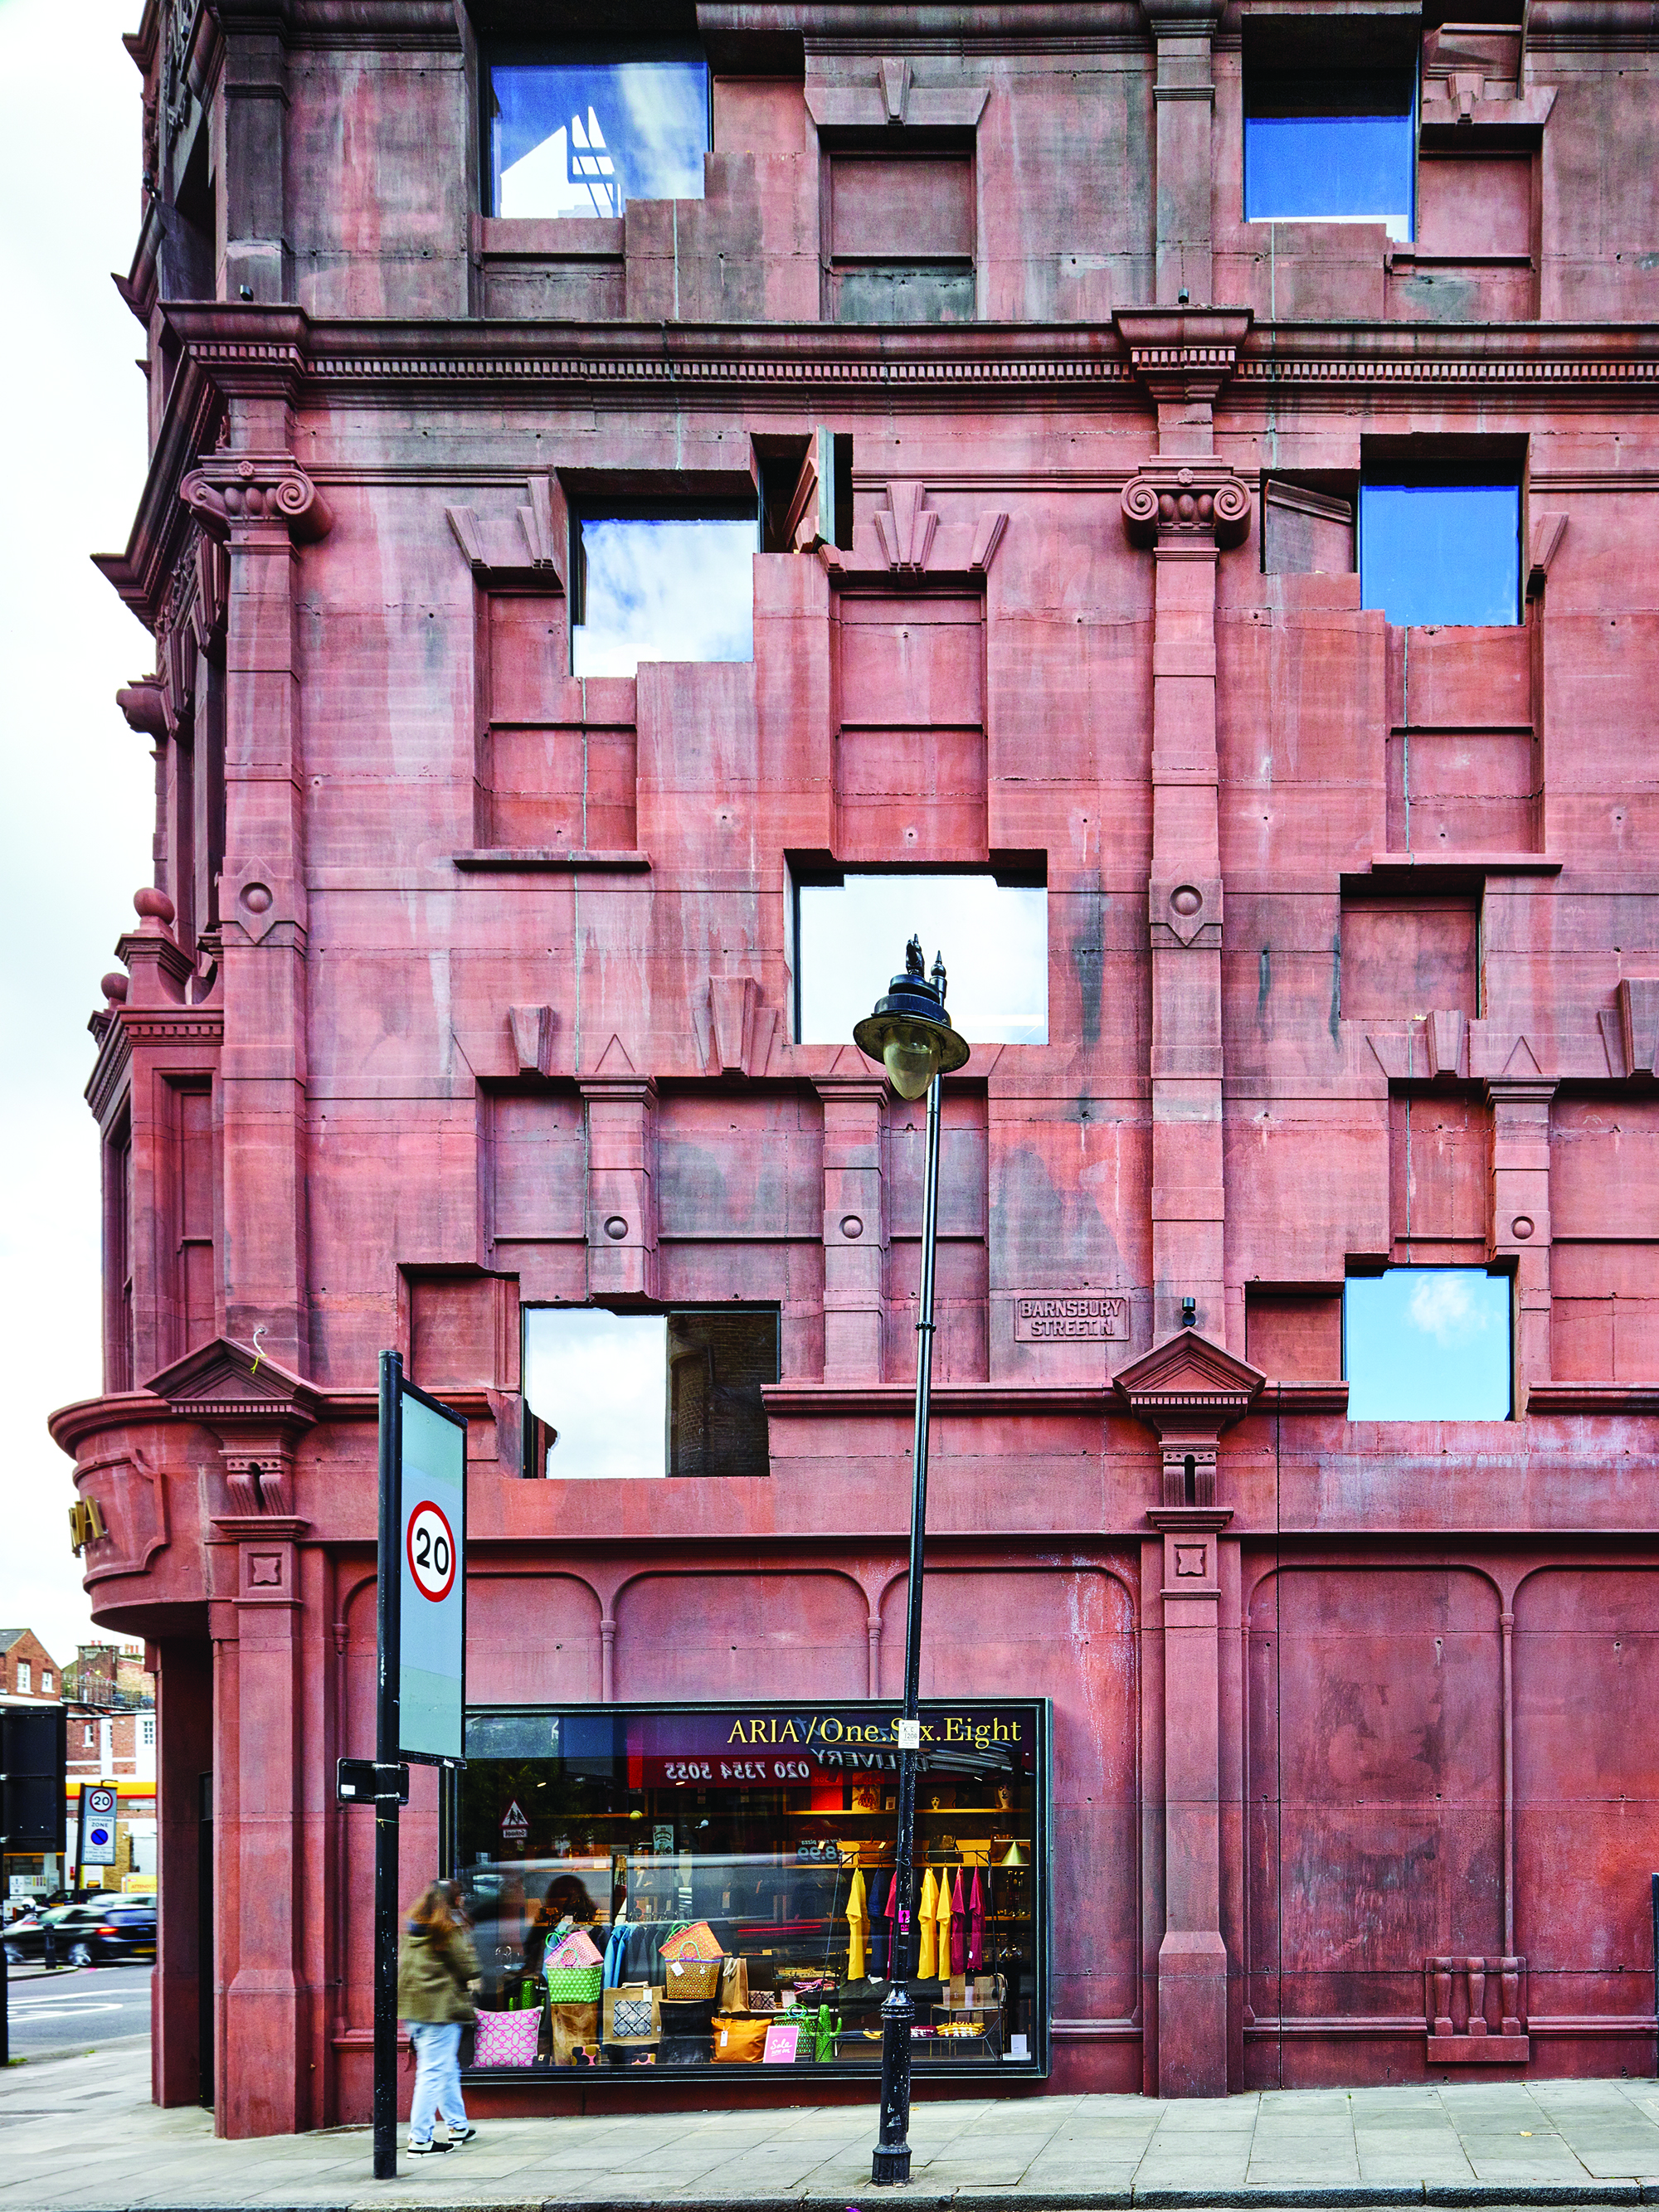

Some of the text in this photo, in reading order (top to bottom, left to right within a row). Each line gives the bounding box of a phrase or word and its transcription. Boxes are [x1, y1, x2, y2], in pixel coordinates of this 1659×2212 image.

[1021, 1300, 1121, 1318] BARNSBURY
[416, 1527, 449, 1575] 20
[727, 1716, 1022, 1749] ARIA/One.Sx.Eight
[94, 1796, 110, 1806] 20
[771, 2038, 792, 2050] Sale
